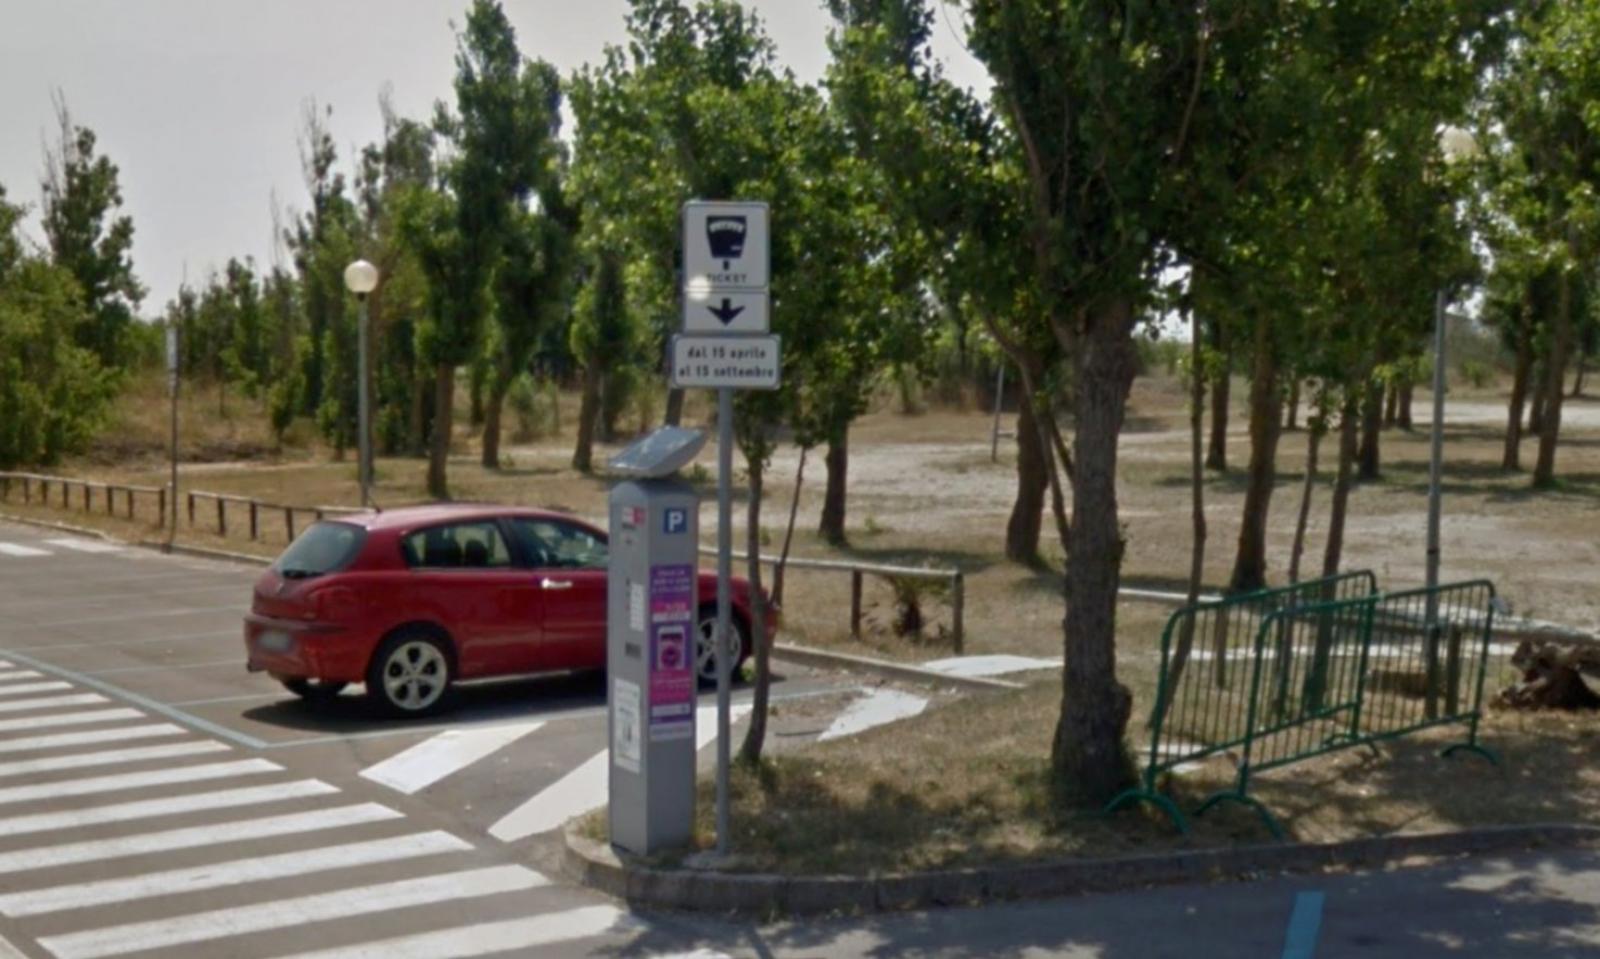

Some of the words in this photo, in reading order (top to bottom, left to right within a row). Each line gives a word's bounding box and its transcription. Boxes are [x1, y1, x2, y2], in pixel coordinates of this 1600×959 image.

[706, 273, 747, 283] TICKET
[688, 346, 706, 358] dal
[713, 346, 725, 358] 15
[730, 346, 766, 360] aprile
[679, 365, 691, 377] al
[696, 365, 709, 377] 15
[714, 365, 774, 378] settembre
[668, 510, 684, 532] P
